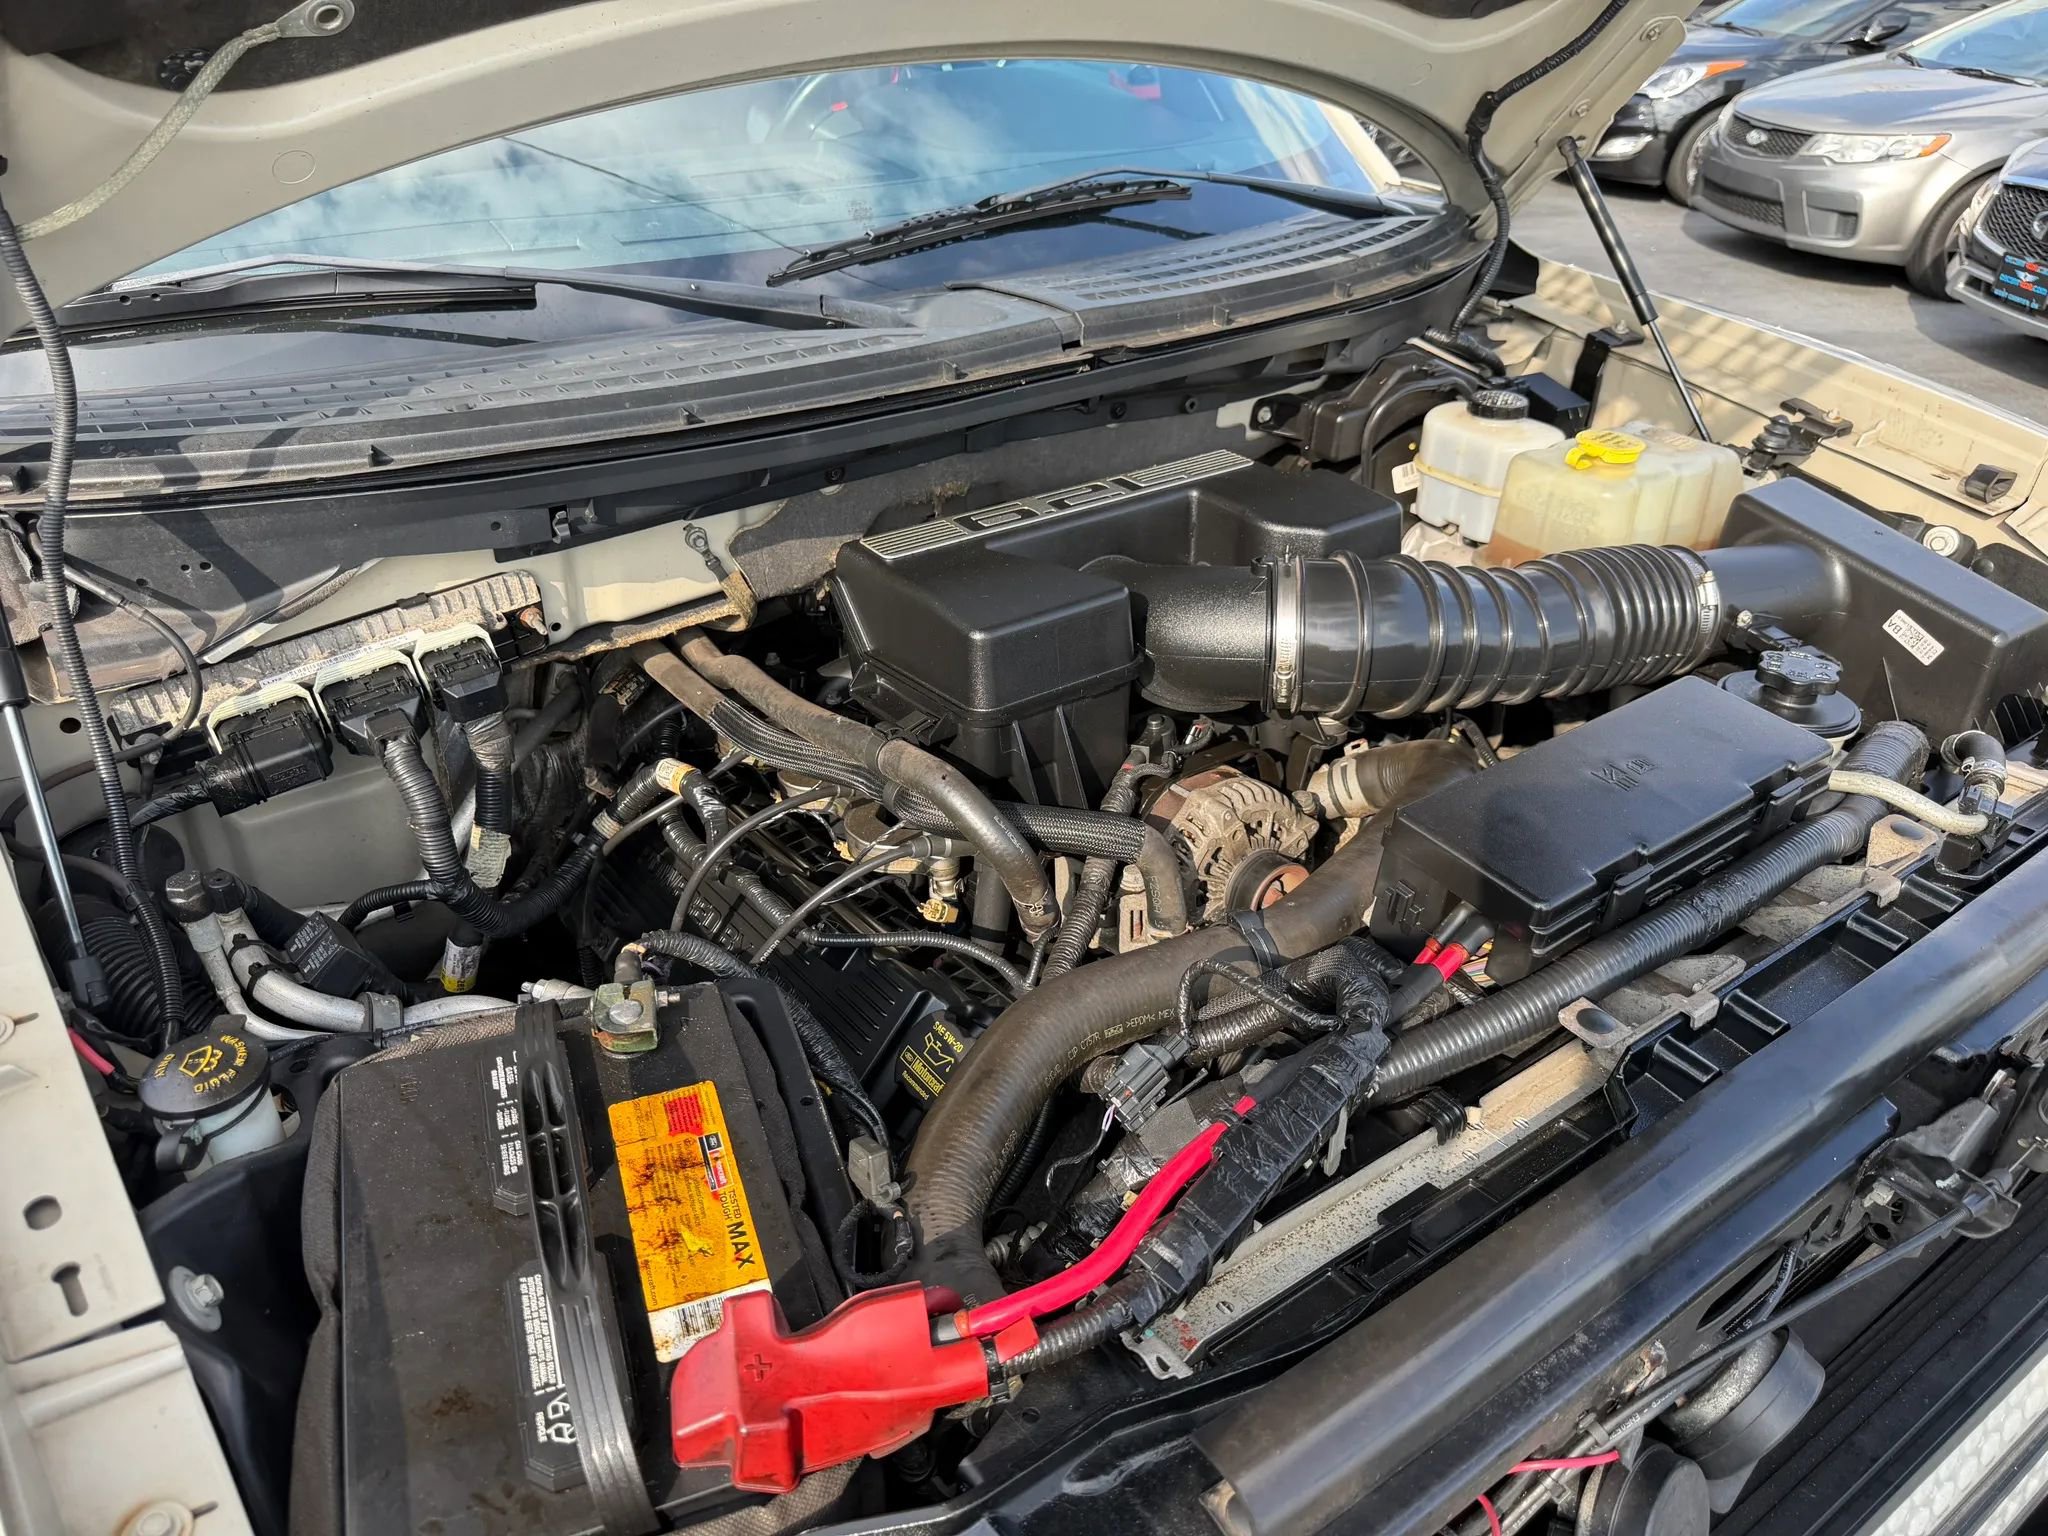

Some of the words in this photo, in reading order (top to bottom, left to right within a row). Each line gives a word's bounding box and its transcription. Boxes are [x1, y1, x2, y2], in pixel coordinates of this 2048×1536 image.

[952, 475, 1188, 532] 6.2L
[1887, 619, 1903, 635] BA
[1158, 1007, 1175, 1021] MEX
[220, 1034, 249, 1067] WASHER
[932, 1021, 946, 1036] SAE
[943, 1031, 964, 1053] 5W-20
[193, 1068, 237, 1095] FLUID
[912, 1059, 945, 1094] Motorcraf
[719, 1191, 732, 1220] TOUGH
[728, 1188, 742, 1219] TESTED
[726, 1220, 756, 1270] MAX
